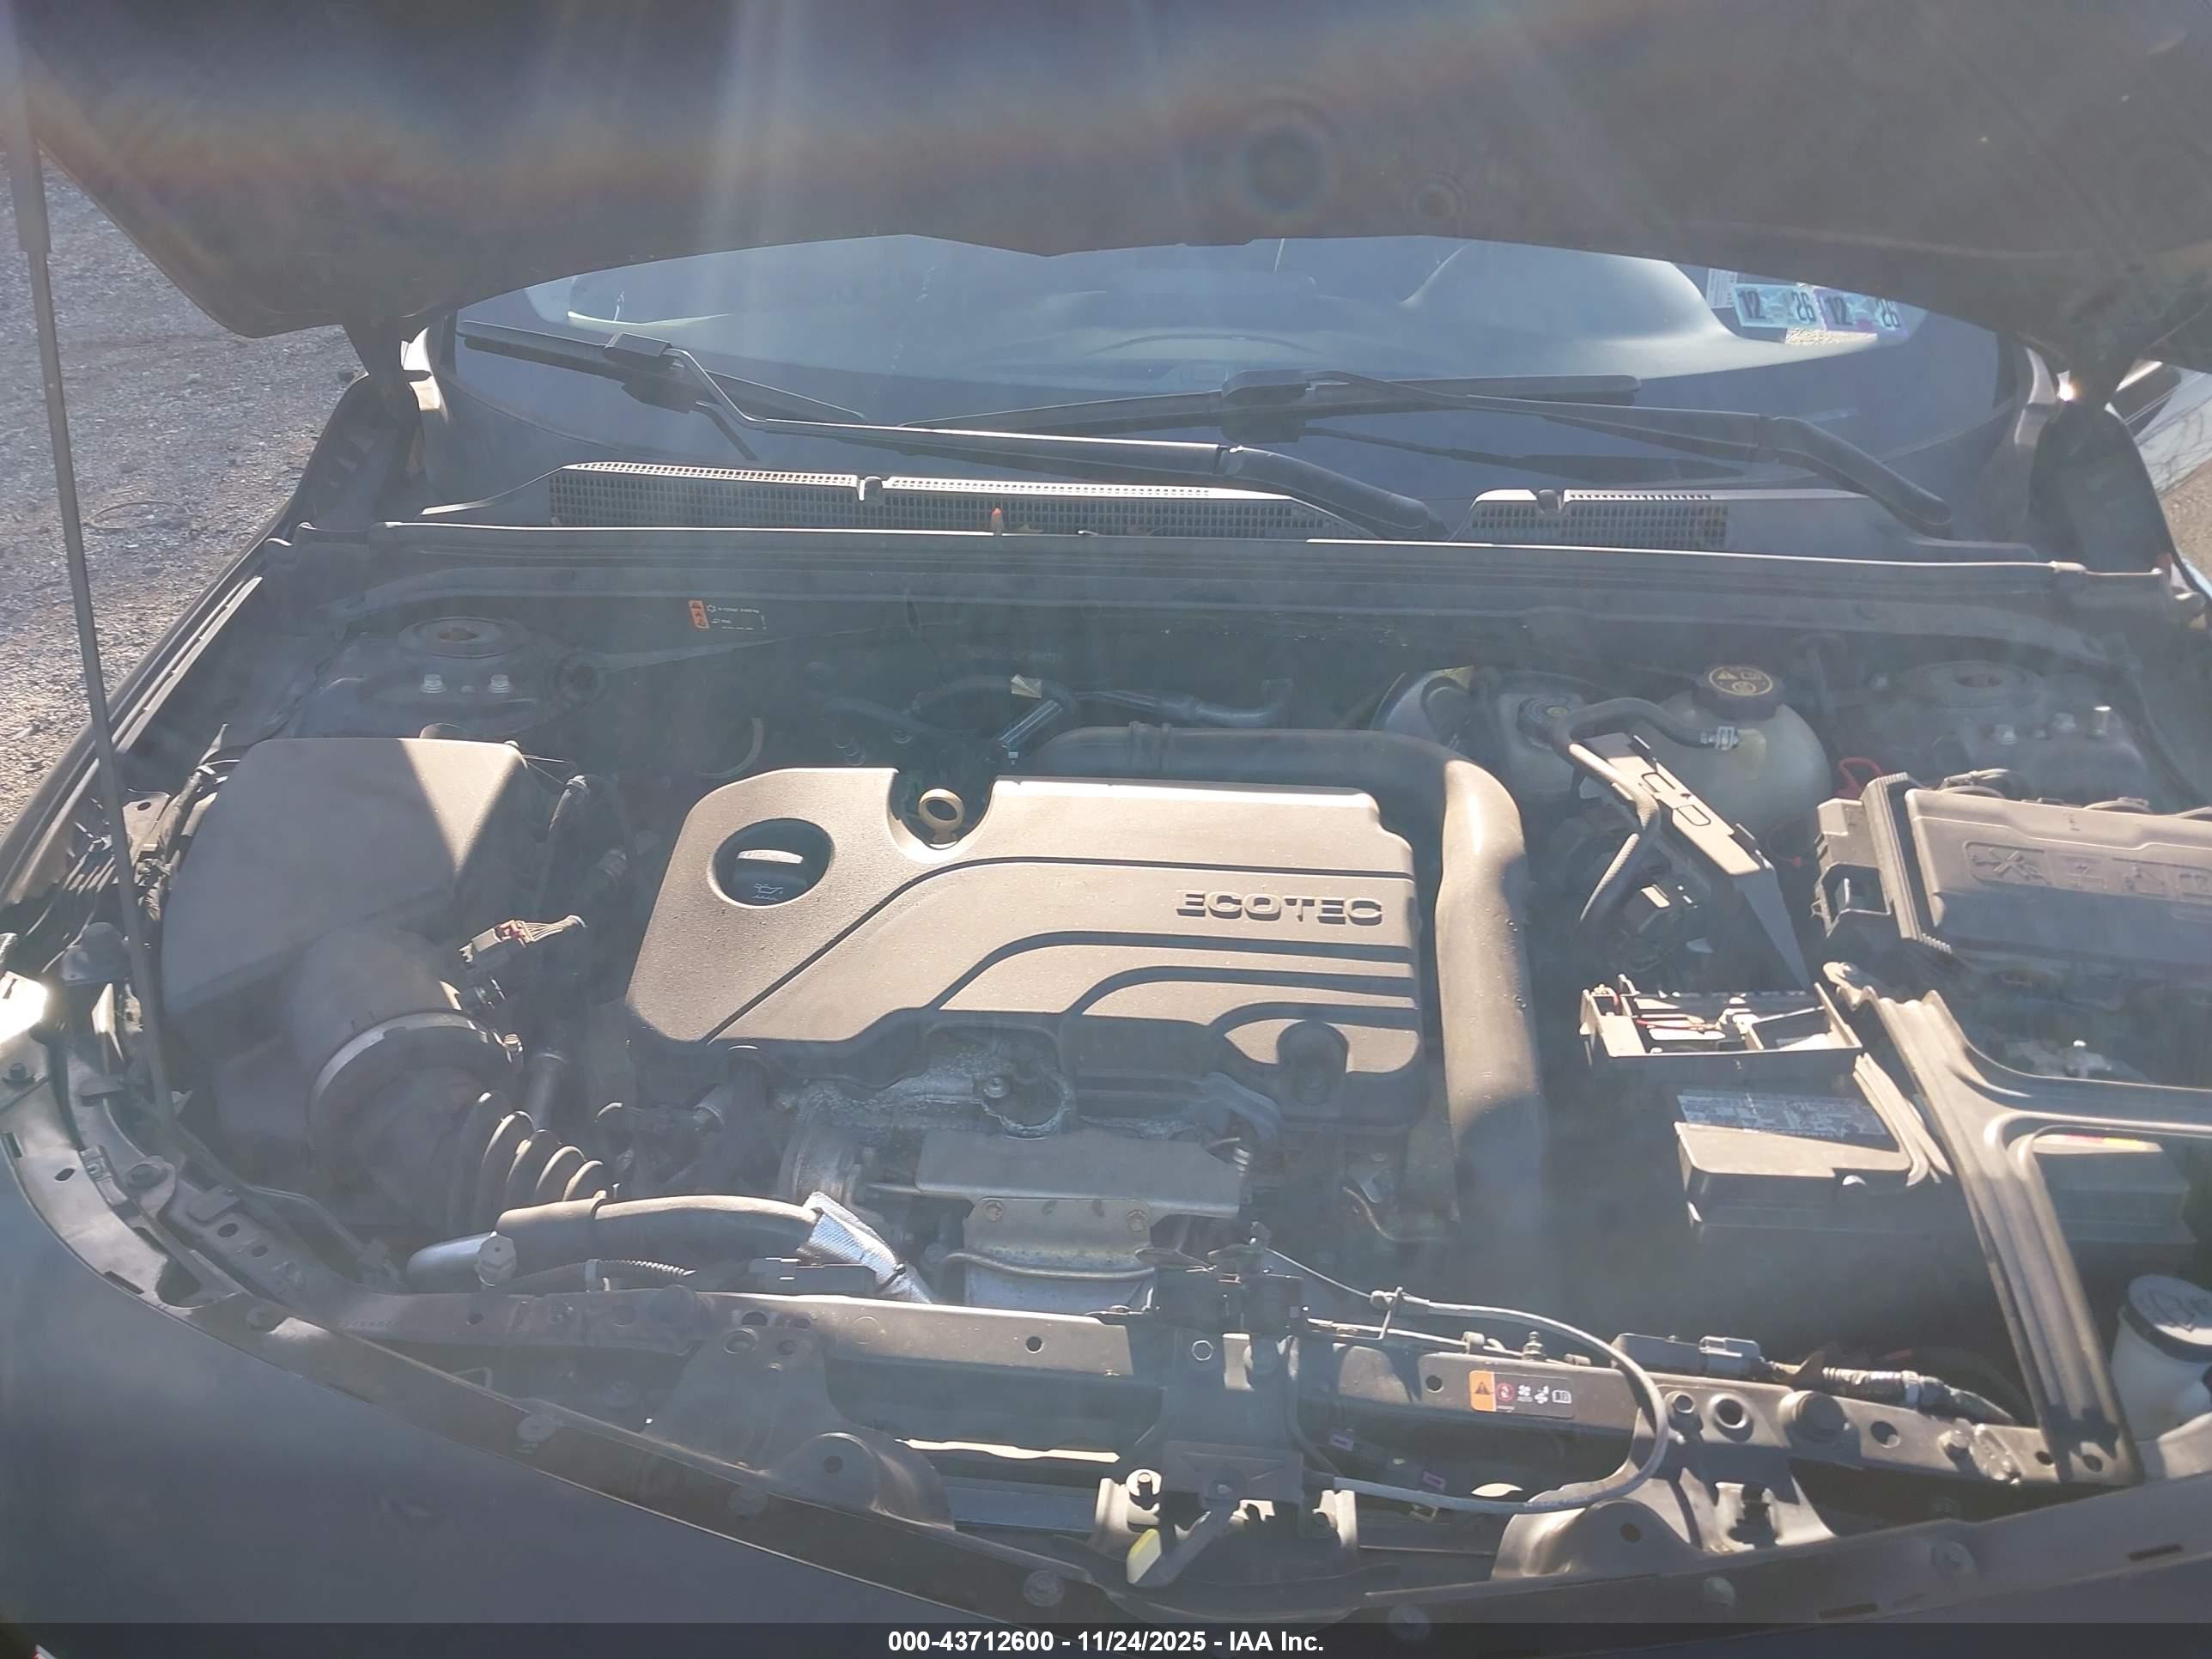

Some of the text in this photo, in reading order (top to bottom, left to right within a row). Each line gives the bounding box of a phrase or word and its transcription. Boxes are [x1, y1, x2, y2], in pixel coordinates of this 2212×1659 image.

[1738, 289, 1817, 323] 12 26
[1826, 296, 1900, 328] 12 26
[1176, 890, 1383, 927] ECOTEC
